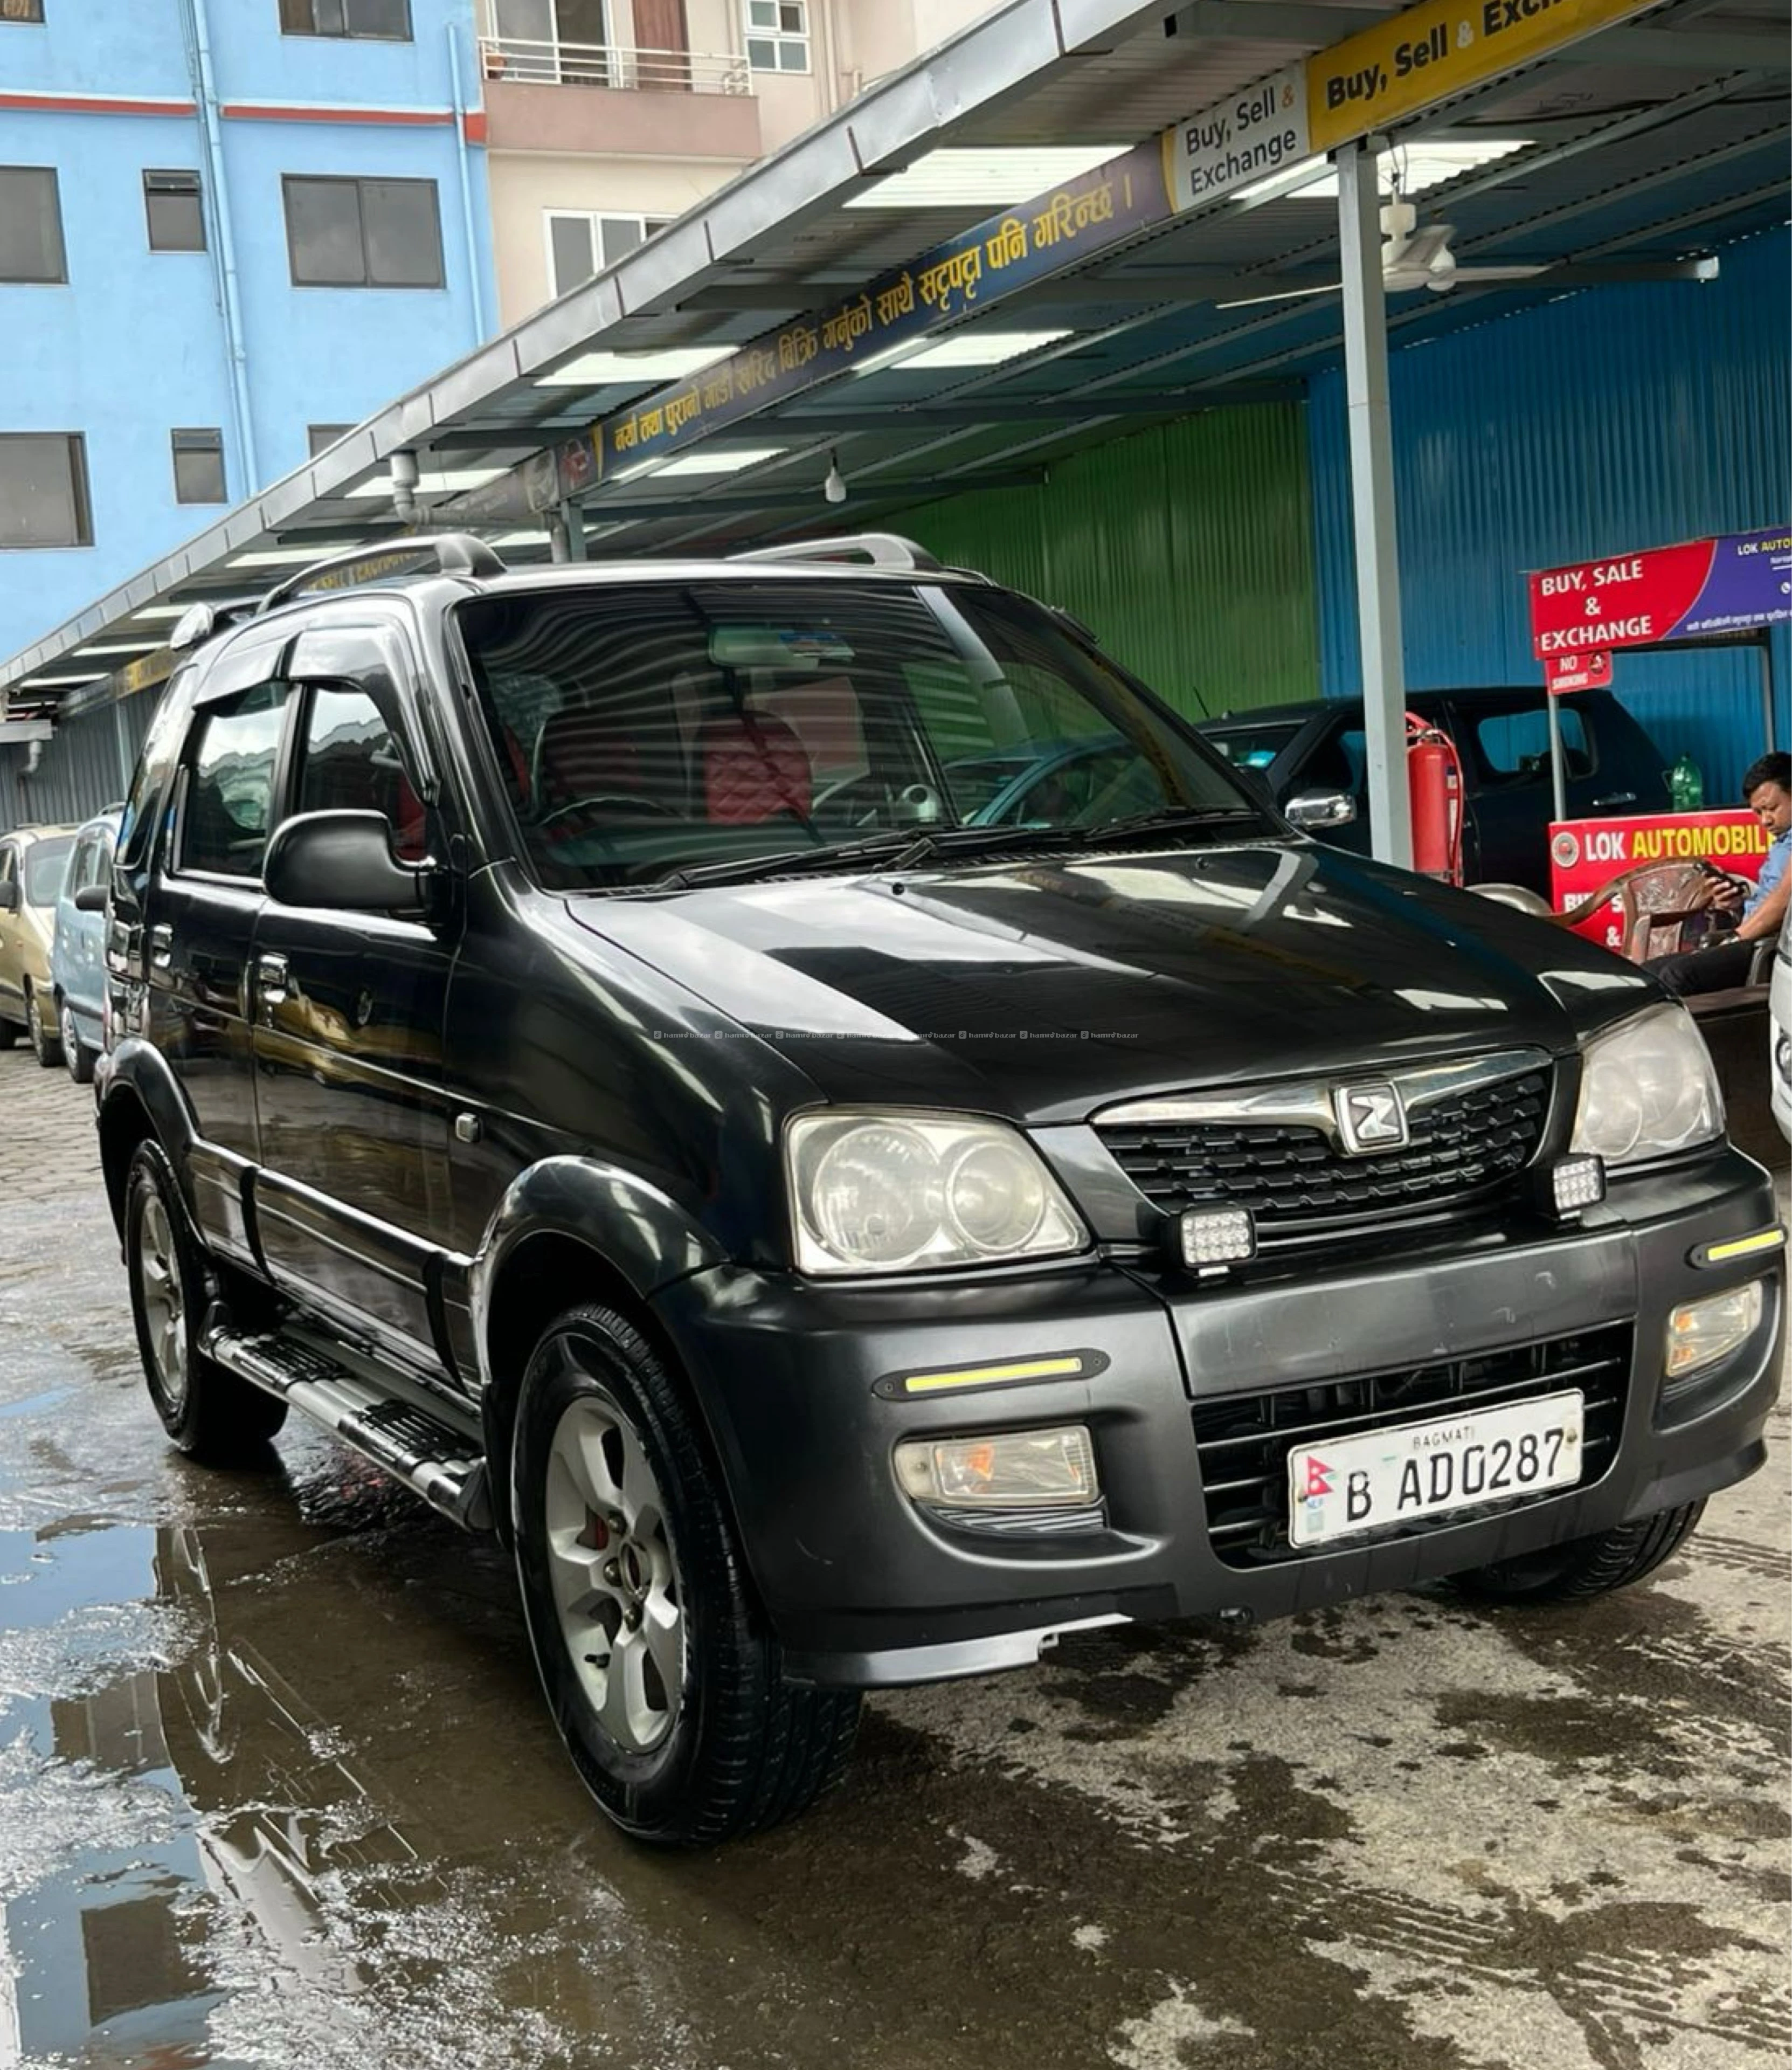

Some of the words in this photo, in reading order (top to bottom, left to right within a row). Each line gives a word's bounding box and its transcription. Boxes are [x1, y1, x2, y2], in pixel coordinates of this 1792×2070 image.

[1327, 64, 1388, 109] Buy,
[1394, 22, 1448, 78] Sell
[1457, 20, 1474, 49] &
[1186, 117, 1231, 156] Buy,
[1237, 86, 1276, 132] Sell
[1282, 84, 1293, 108] &
[1191, 129, 1296, 195] Exchange
[876, 271, 915, 326] साथै
[986, 217, 1028, 269] पनि
[1032, 182, 1114, 249] गरिन्छ
[1738, 543, 1758, 556] LOK
[1541, 570, 1587, 596] BUY,
[1593, 559, 1643, 586] SALE
[1585, 596, 1602, 616] &
[1541, 615, 1652, 652] EXCHANGE
[1560, 655, 1577, 673] NO
[1585, 832, 1625, 861] LOK
[1607, 926, 1622, 947] &
[1413, 1425, 1476, 1450] BAGMATI
[1347, 1470, 1372, 1522] B
